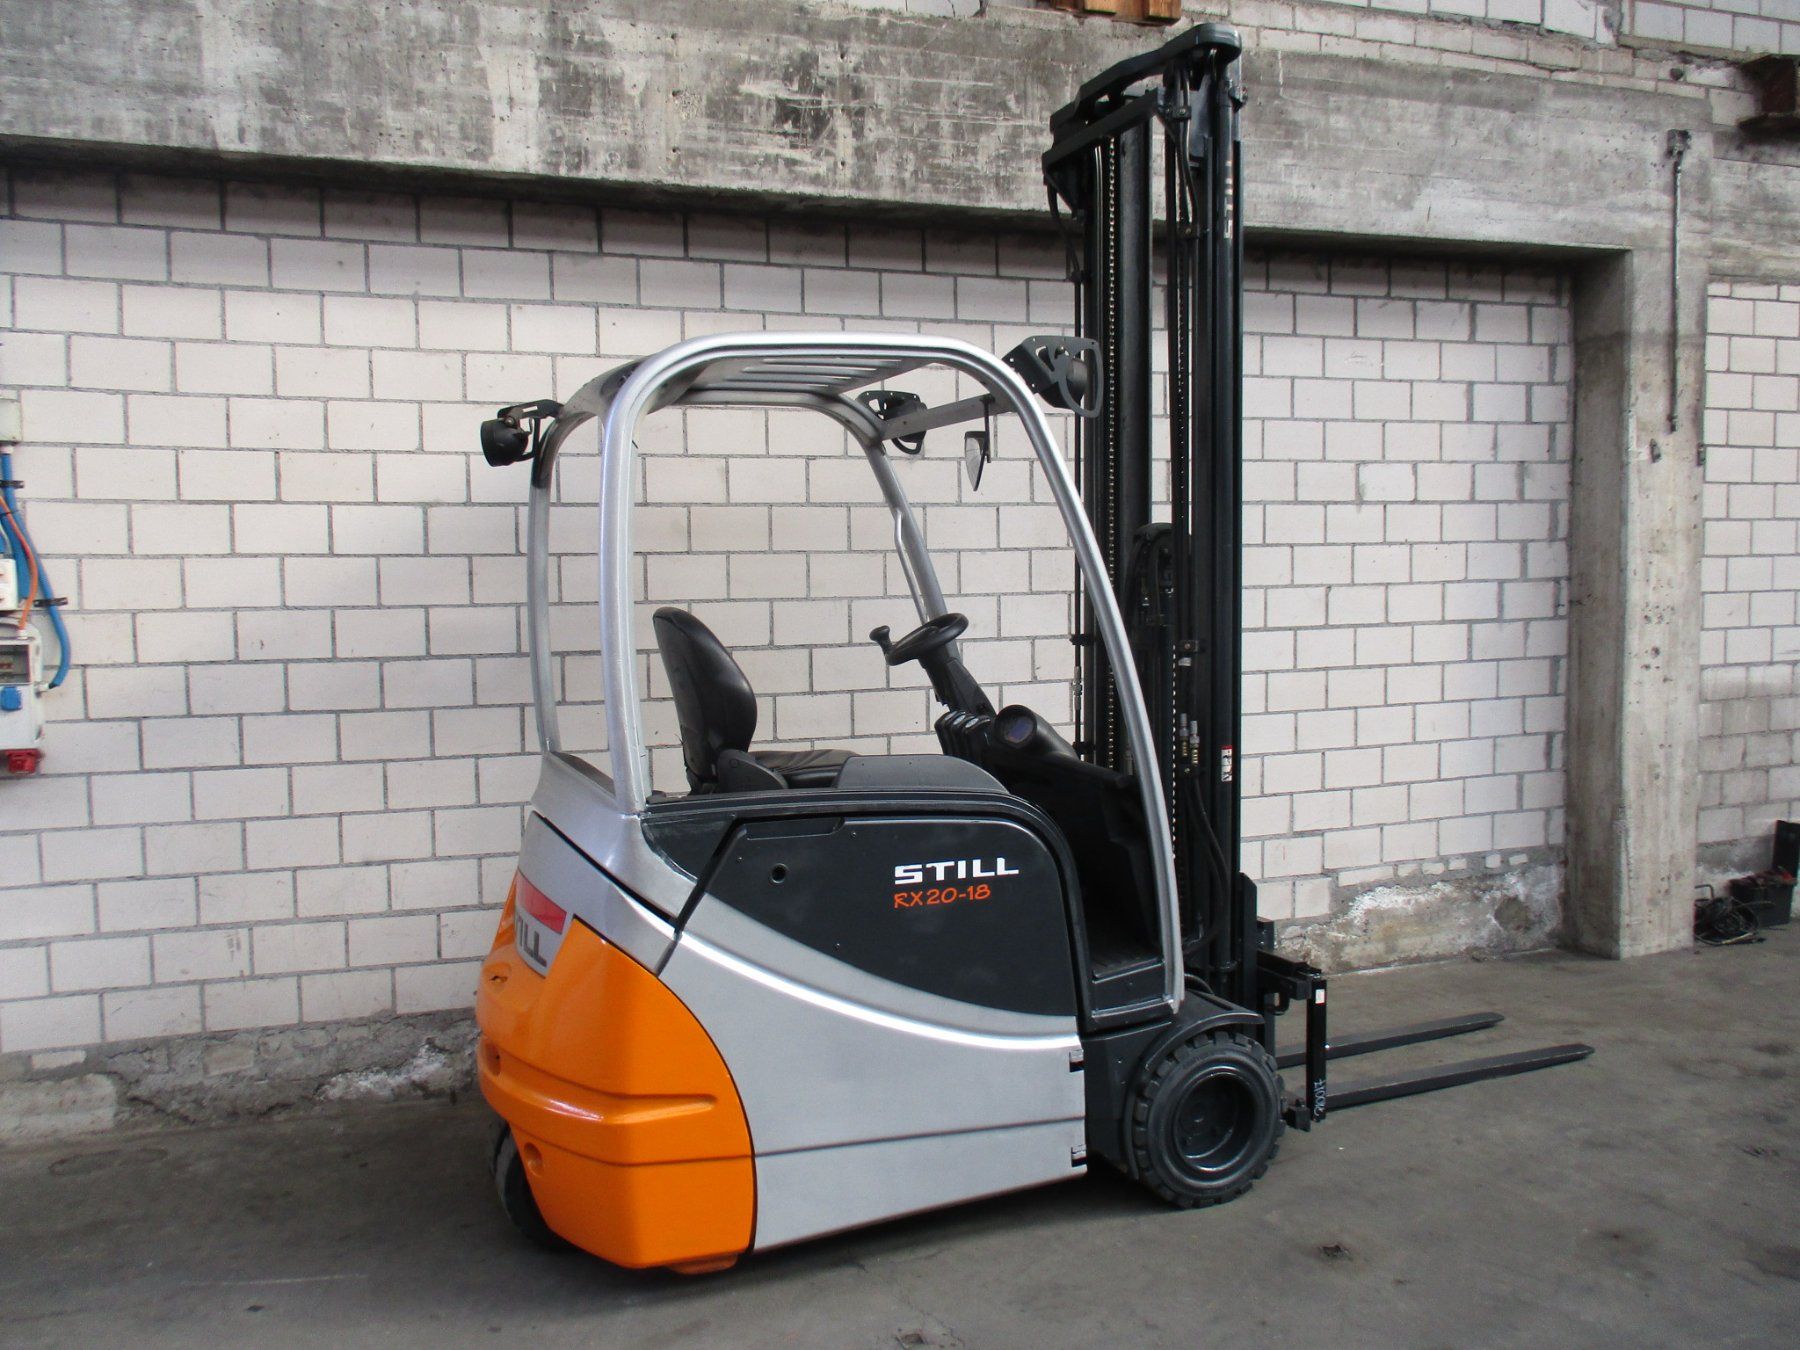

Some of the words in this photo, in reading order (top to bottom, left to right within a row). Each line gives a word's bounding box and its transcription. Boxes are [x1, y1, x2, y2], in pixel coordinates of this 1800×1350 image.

[894, 857, 1020, 885] STILL
[893, 884, 992, 909] RX20-18
[518, 915, 547, 967] ILL
